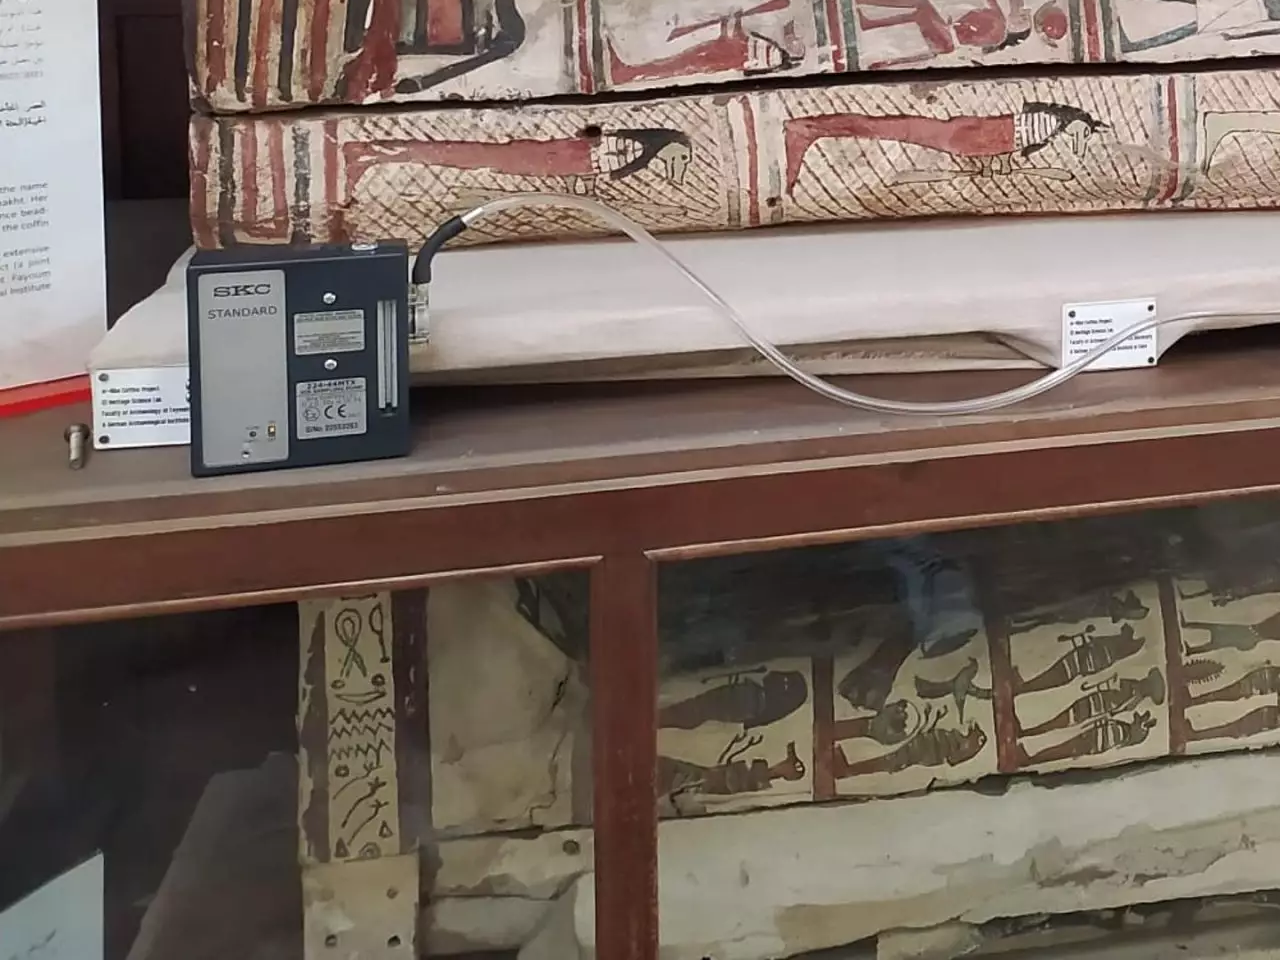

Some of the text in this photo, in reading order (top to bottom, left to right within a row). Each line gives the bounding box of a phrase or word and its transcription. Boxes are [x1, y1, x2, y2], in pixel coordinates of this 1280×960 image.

[21, 219, 49, 231] coffin
[213, 284, 271, 297] SKC
[207, 305, 278, 320] STANDARD
